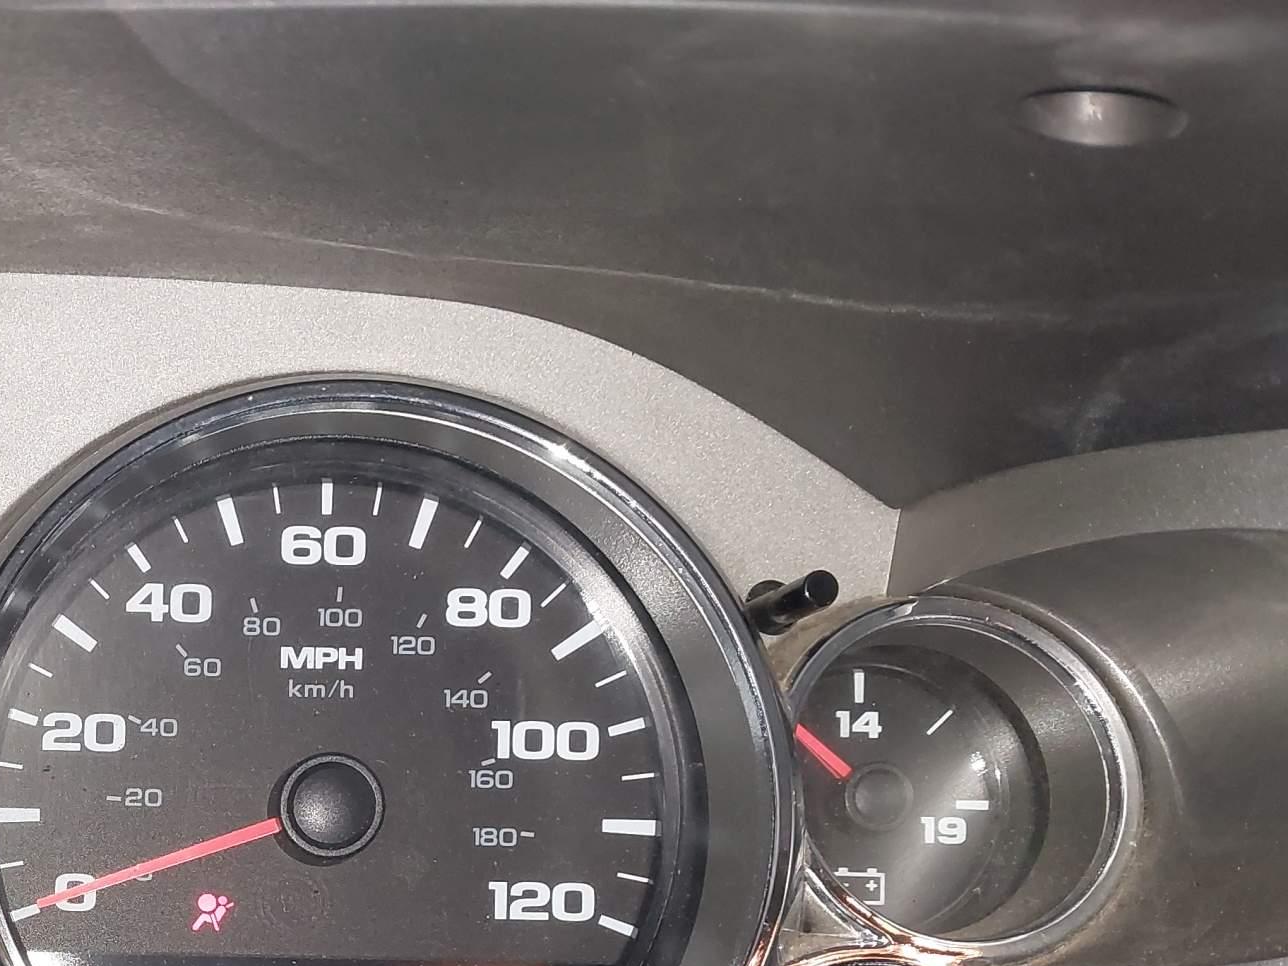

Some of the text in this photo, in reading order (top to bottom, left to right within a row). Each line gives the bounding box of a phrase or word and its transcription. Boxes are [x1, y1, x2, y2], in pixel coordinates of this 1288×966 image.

[281, 525, 367, 566] 60
[125, 582, 212, 623] 40
[445, 587, 532, 628] 80
[243, 617, 281, 636] 80
[318, 608, 363, 627] 100
[390, 636, 435, 655] 120
[182, 656, 222, 677] 60
[280, 646, 363, 670] MPH
[288, 679, 354, 698] km/h
[443, 689, 488, 709] 140
[41, 712, 126, 753] 20
[140, 718, 178, 737] 40
[835, 710, 883, 739] 14
[490, 720, 600, 761] 100
[468, 769, 513, 789] 160
[124, 787, 162, 807] 20
[472, 827, 516, 847] 180
[920, 816, 967, 845] 19
[55, 873, 97, 912] 0
[488, 881, 597, 922] 120
